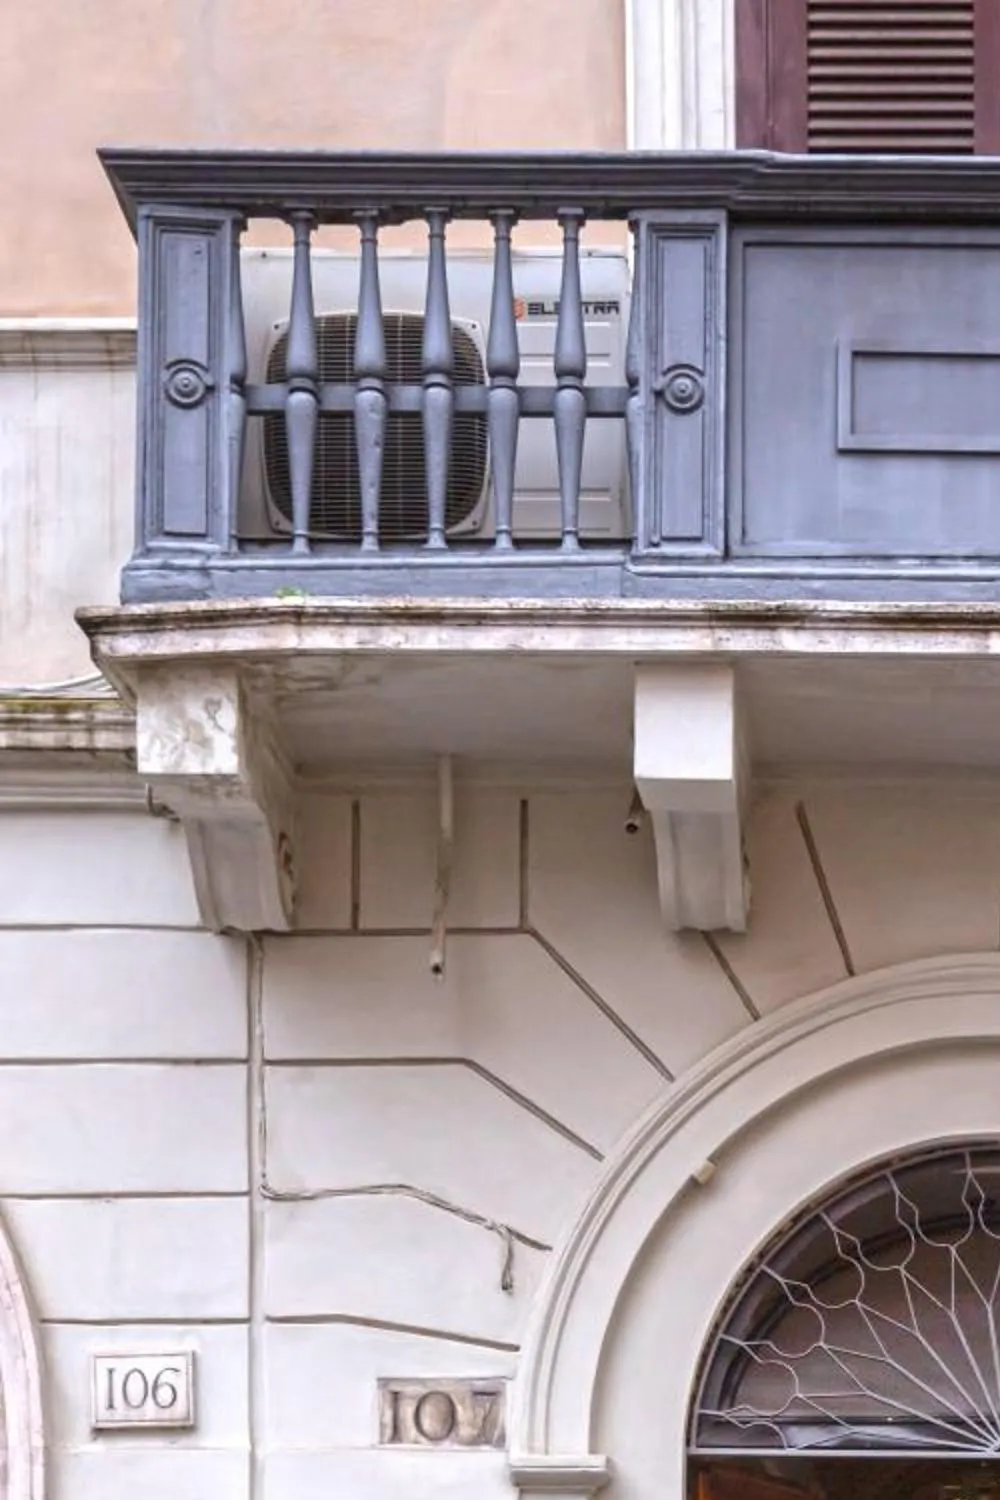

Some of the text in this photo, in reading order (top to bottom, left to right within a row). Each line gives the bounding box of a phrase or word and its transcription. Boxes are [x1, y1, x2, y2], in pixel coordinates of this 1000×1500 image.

[527, 301, 620, 315] ELTRA
[105, 1367, 181, 1410] 106
[389, 1389, 502, 1444] 107
